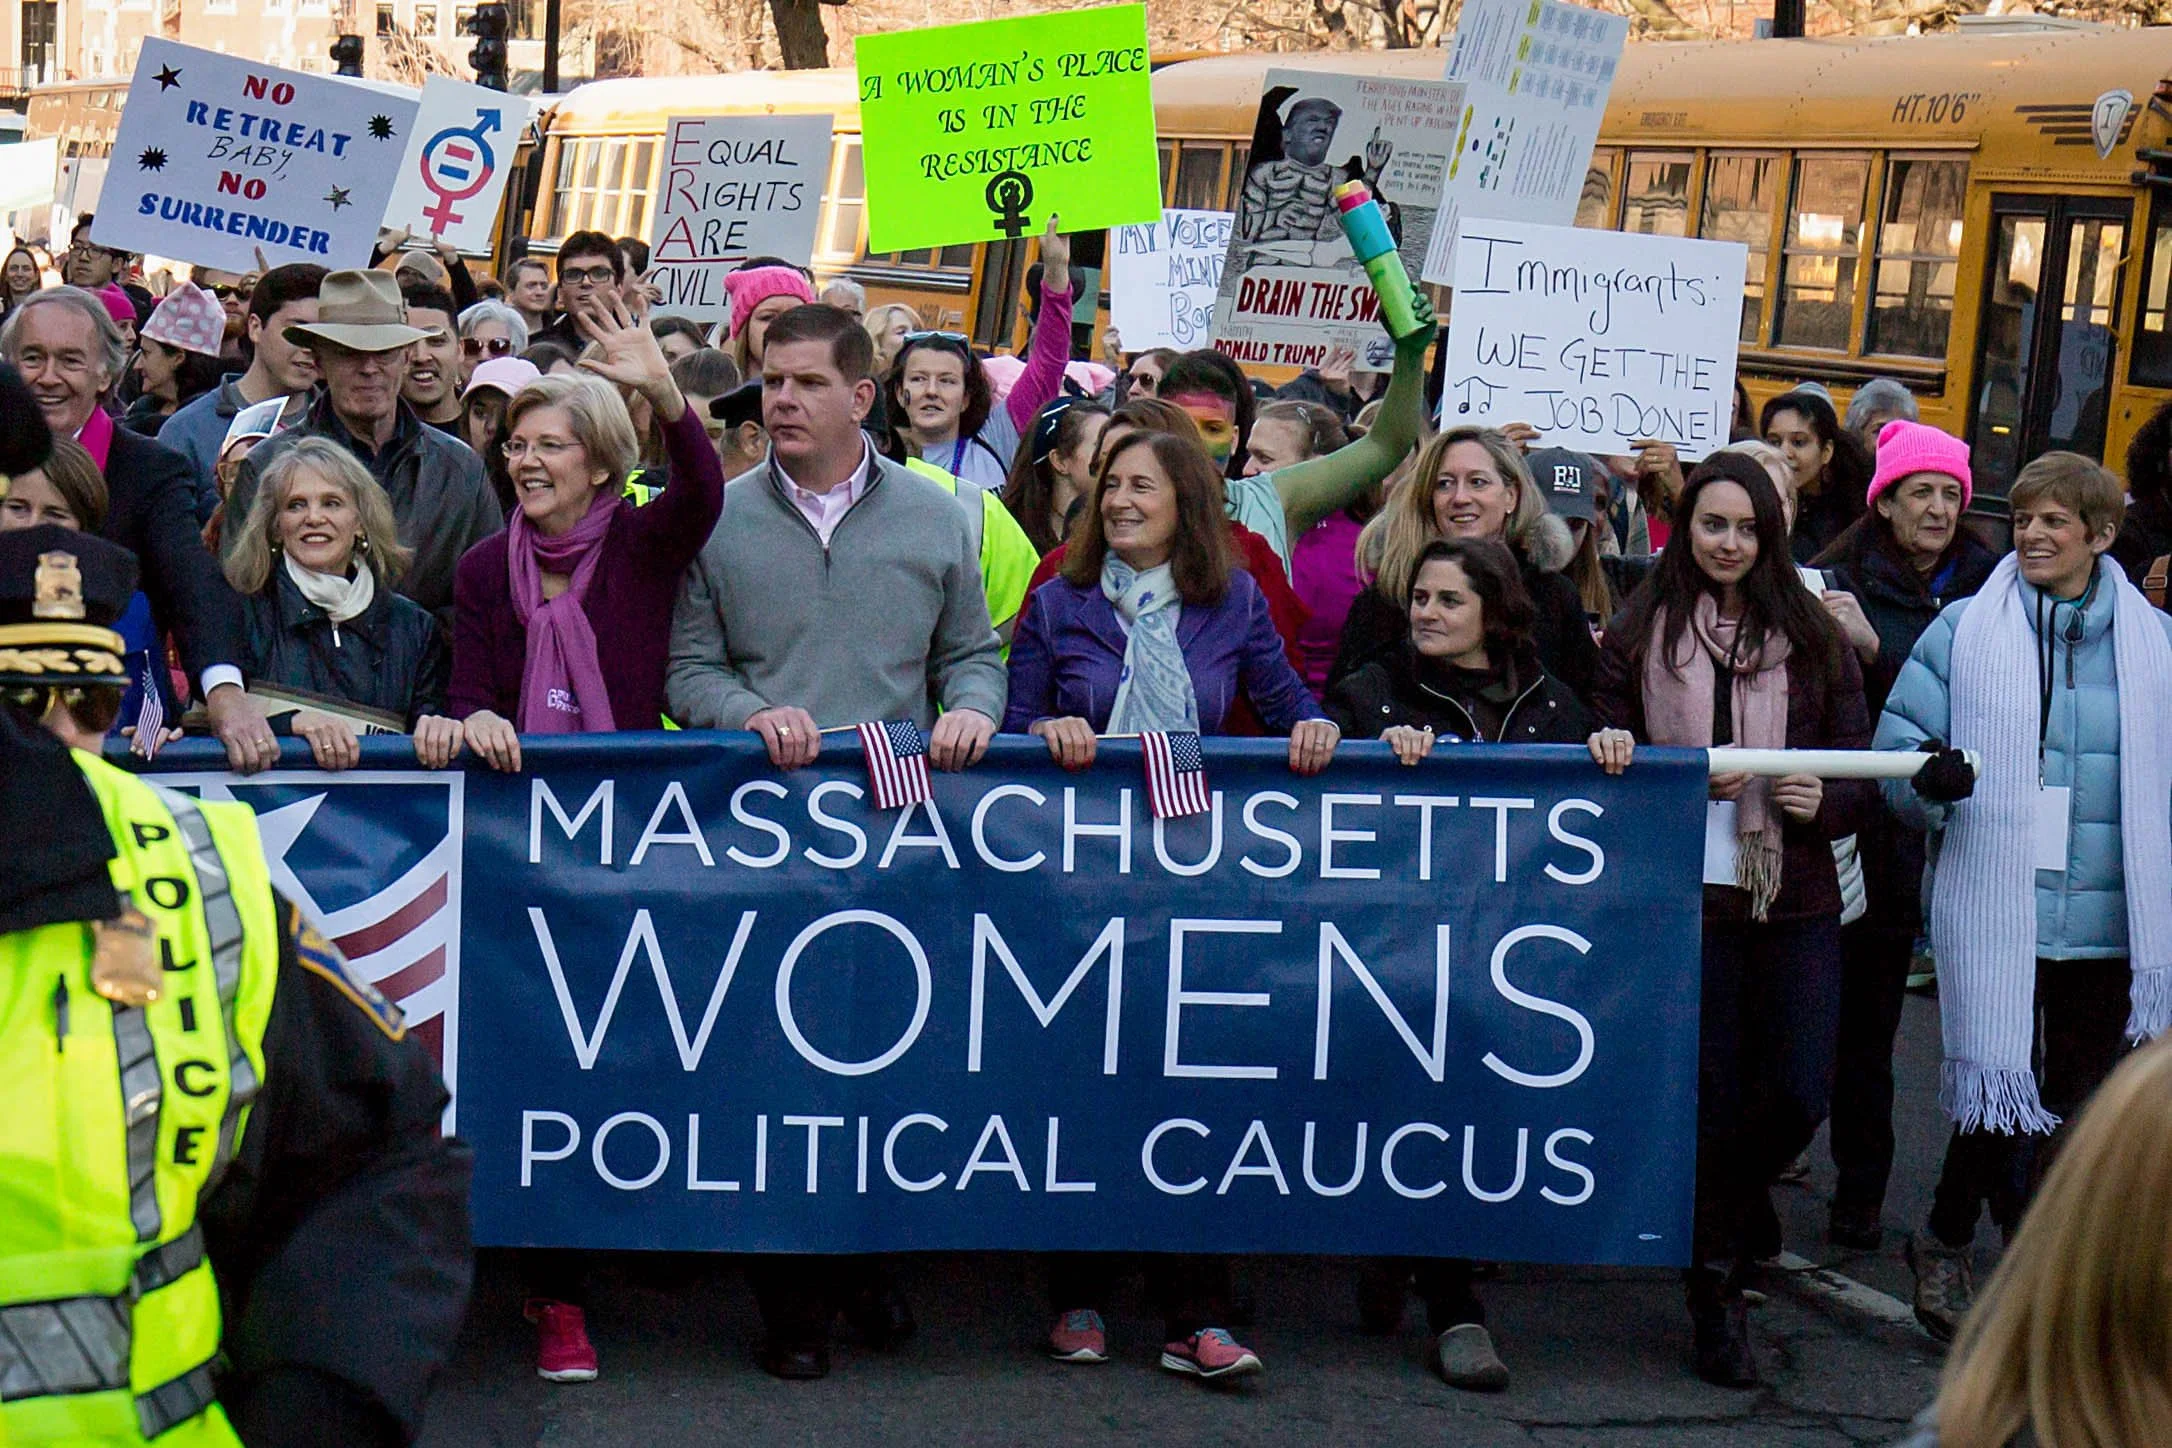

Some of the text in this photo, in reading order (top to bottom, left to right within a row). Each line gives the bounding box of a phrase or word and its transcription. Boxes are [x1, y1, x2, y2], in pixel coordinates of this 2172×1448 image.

[243, 75, 295, 105] NO
[861, 75, 882, 101] A
[1057, 47, 1145, 78] PLACE
[938, 95, 1087, 133] IS IN THE
[208, 136, 293, 181] BABY,
[671, 120, 799, 167] EQUAL
[920, 138, 1093, 181] RESISTANCE
[217, 170, 267, 200] NO
[664, 168, 804, 214] RIGHTS
[138, 192, 331, 254] SURRENDER
[655, 216, 748, 258] ARE
[1120, 212, 1231, 254] MY VOICE
[650, 266, 715, 307] CIVIL
[1237, 276, 1306, 318] DRAIN
[1309, 282, 1349, 321] THE
[1461, 235, 1720, 336] Immigrants:
[1214, 338, 1327, 367] DONALD TRUMP
[1477, 327, 1718, 391] WE GET THE
[1523, 390, 1718, 448] JOB DONE!
[528, 777, 1605, 885] MASSACHUSETTS
[132, 821, 217, 1165] POLICE
[526, 906, 1596, 1089] WOMENS
[519, 1109, 1595, 1206] POLITICAL CAUCUS
